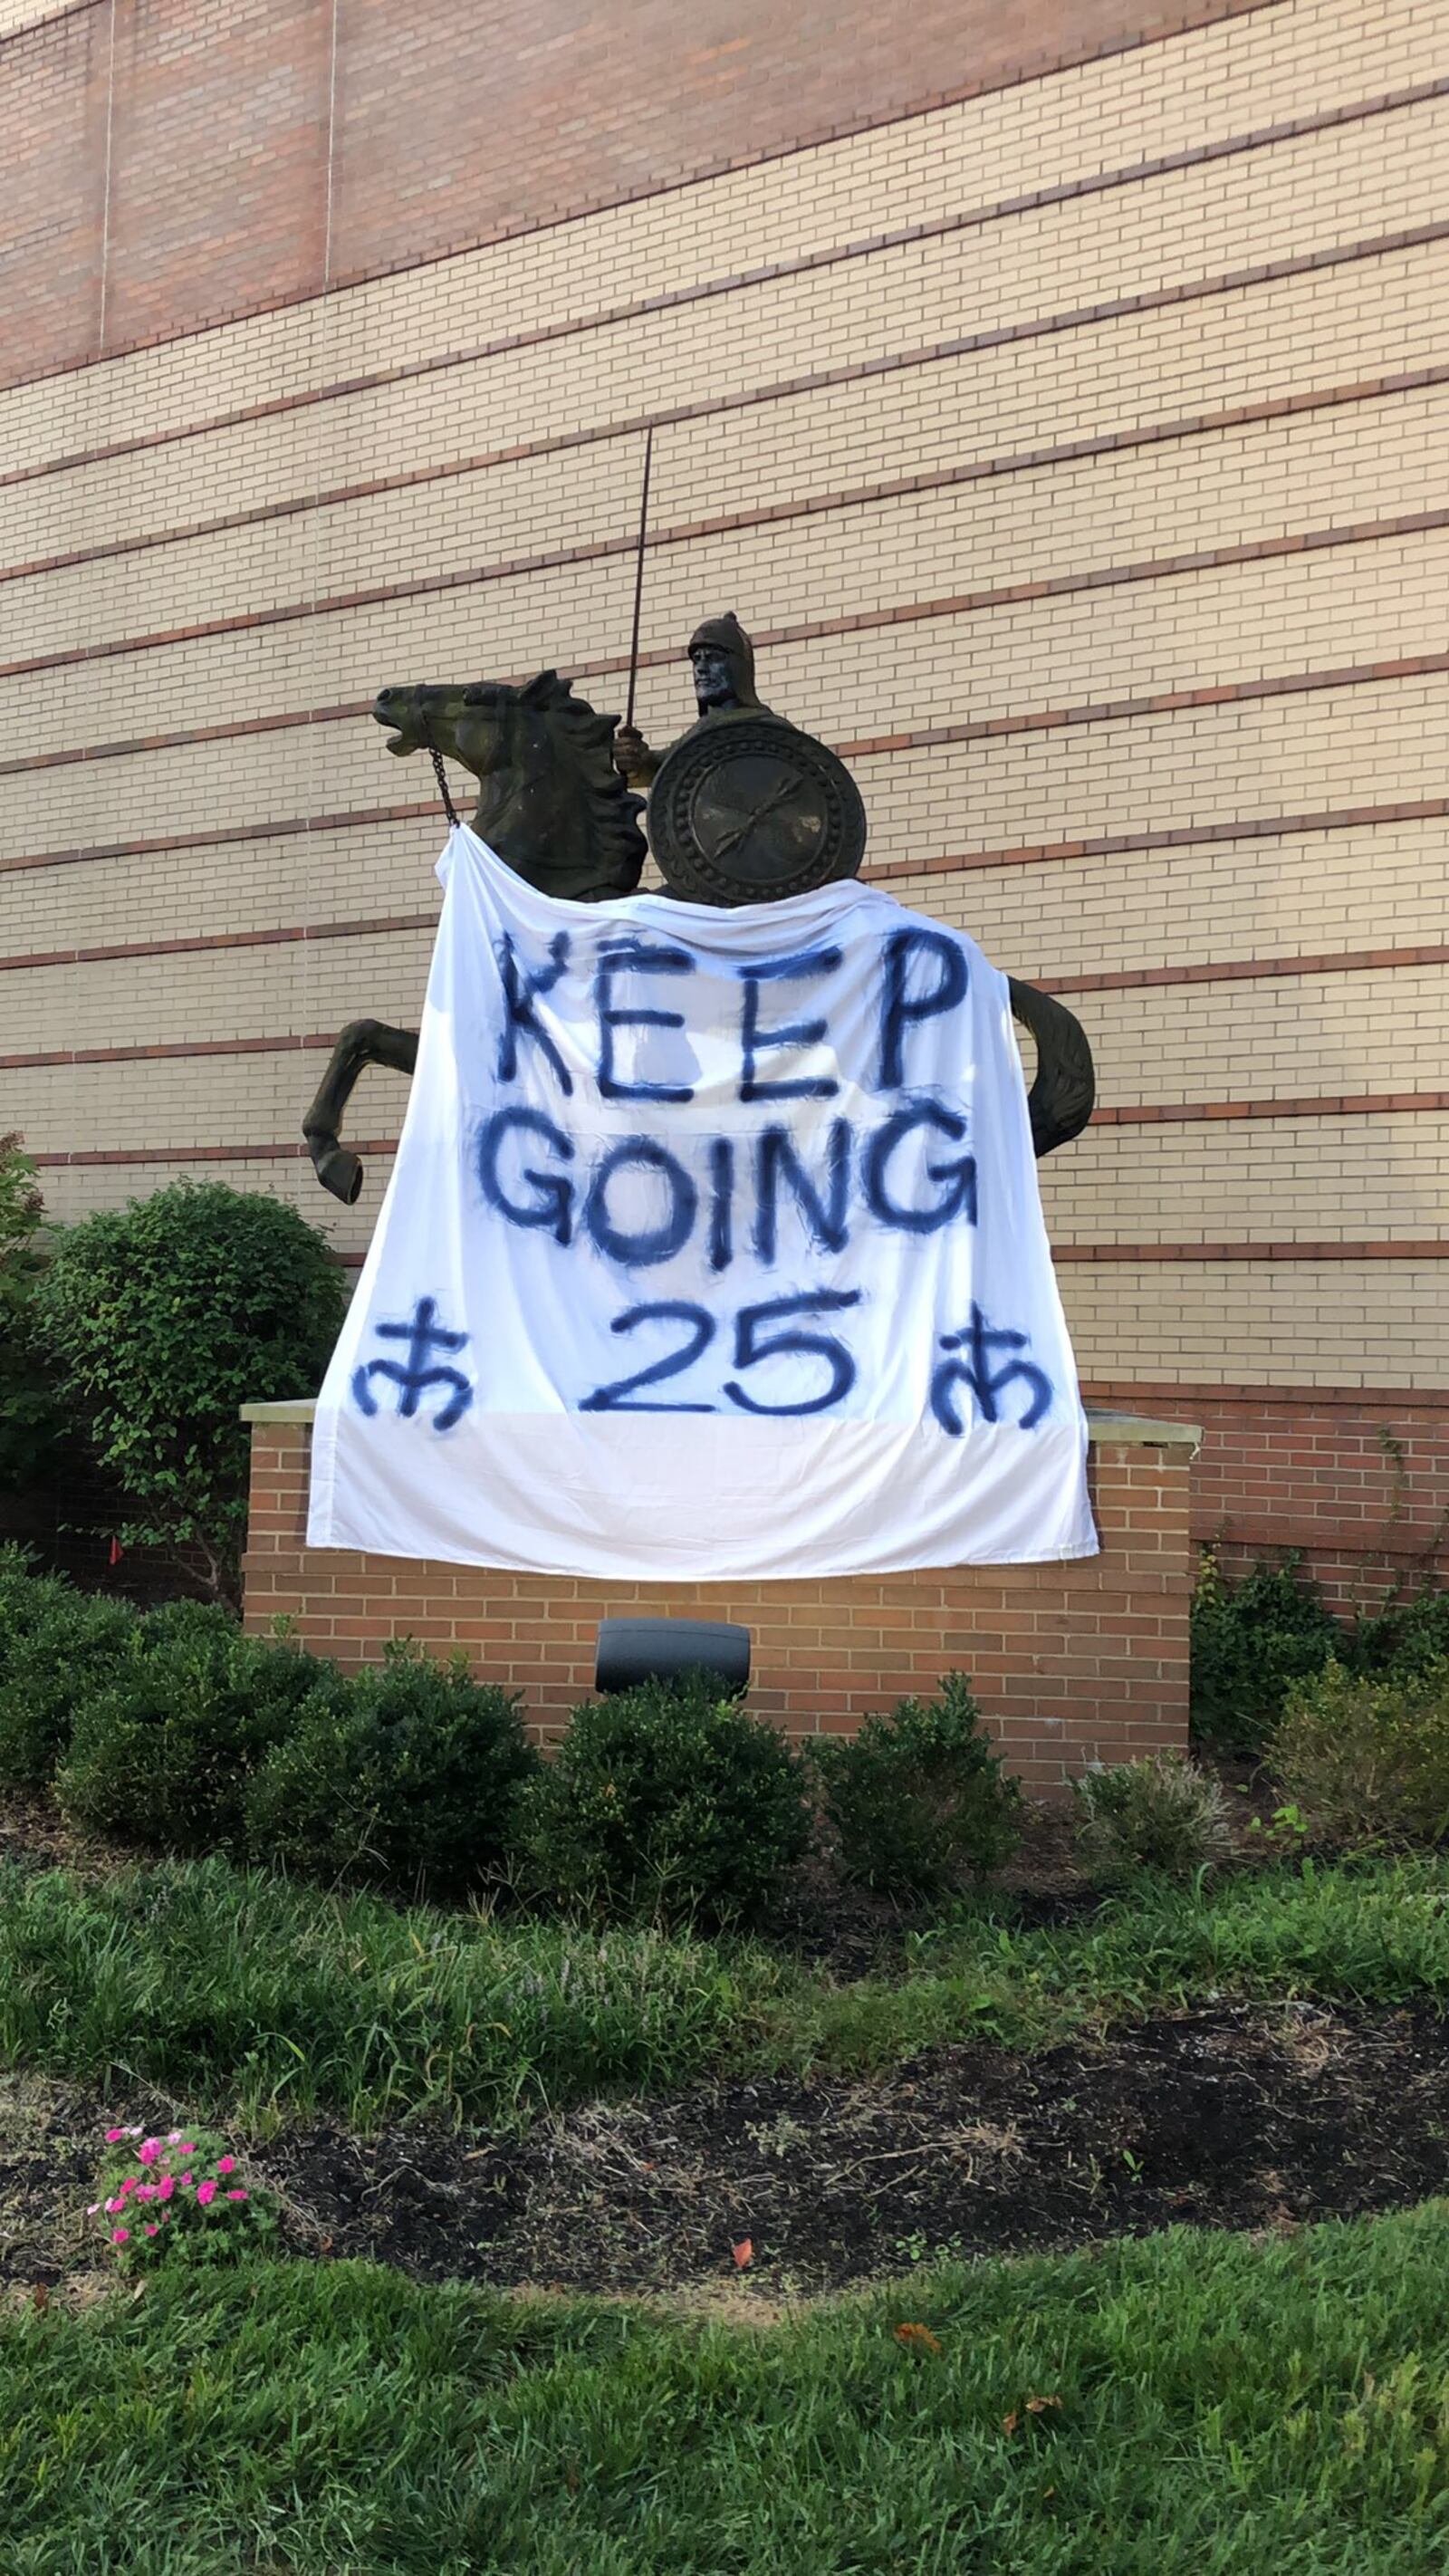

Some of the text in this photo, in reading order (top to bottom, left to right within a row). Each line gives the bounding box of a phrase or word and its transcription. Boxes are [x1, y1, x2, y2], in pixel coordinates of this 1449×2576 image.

[494, 927, 970, 1103] KEEP
[476, 1098, 978, 1272] GOING
[578, 1287, 861, 1416] 25
